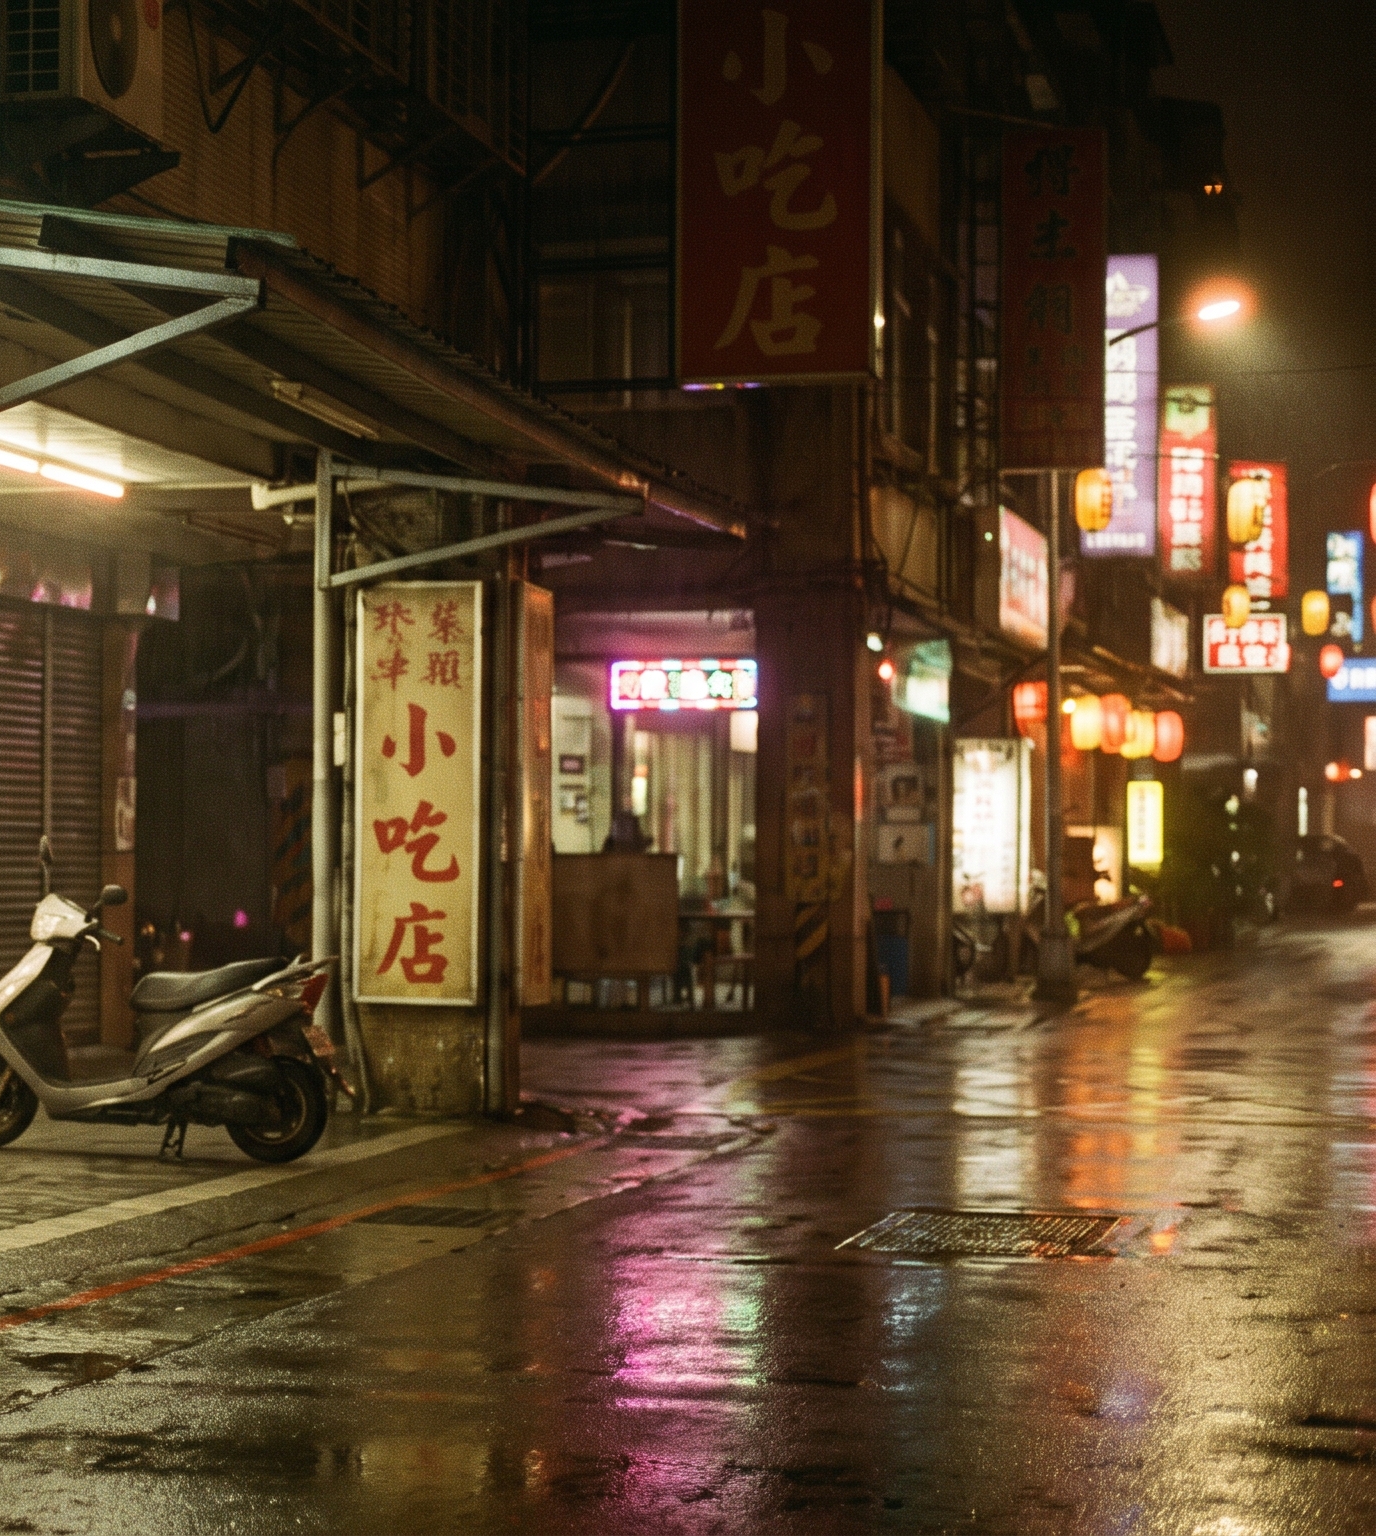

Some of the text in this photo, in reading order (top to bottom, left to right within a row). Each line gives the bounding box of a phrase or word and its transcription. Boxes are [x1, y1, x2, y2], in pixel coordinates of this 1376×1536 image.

[714, 8, 838, 356] 小吃店
[373, 702, 460, 983] 小吃店
